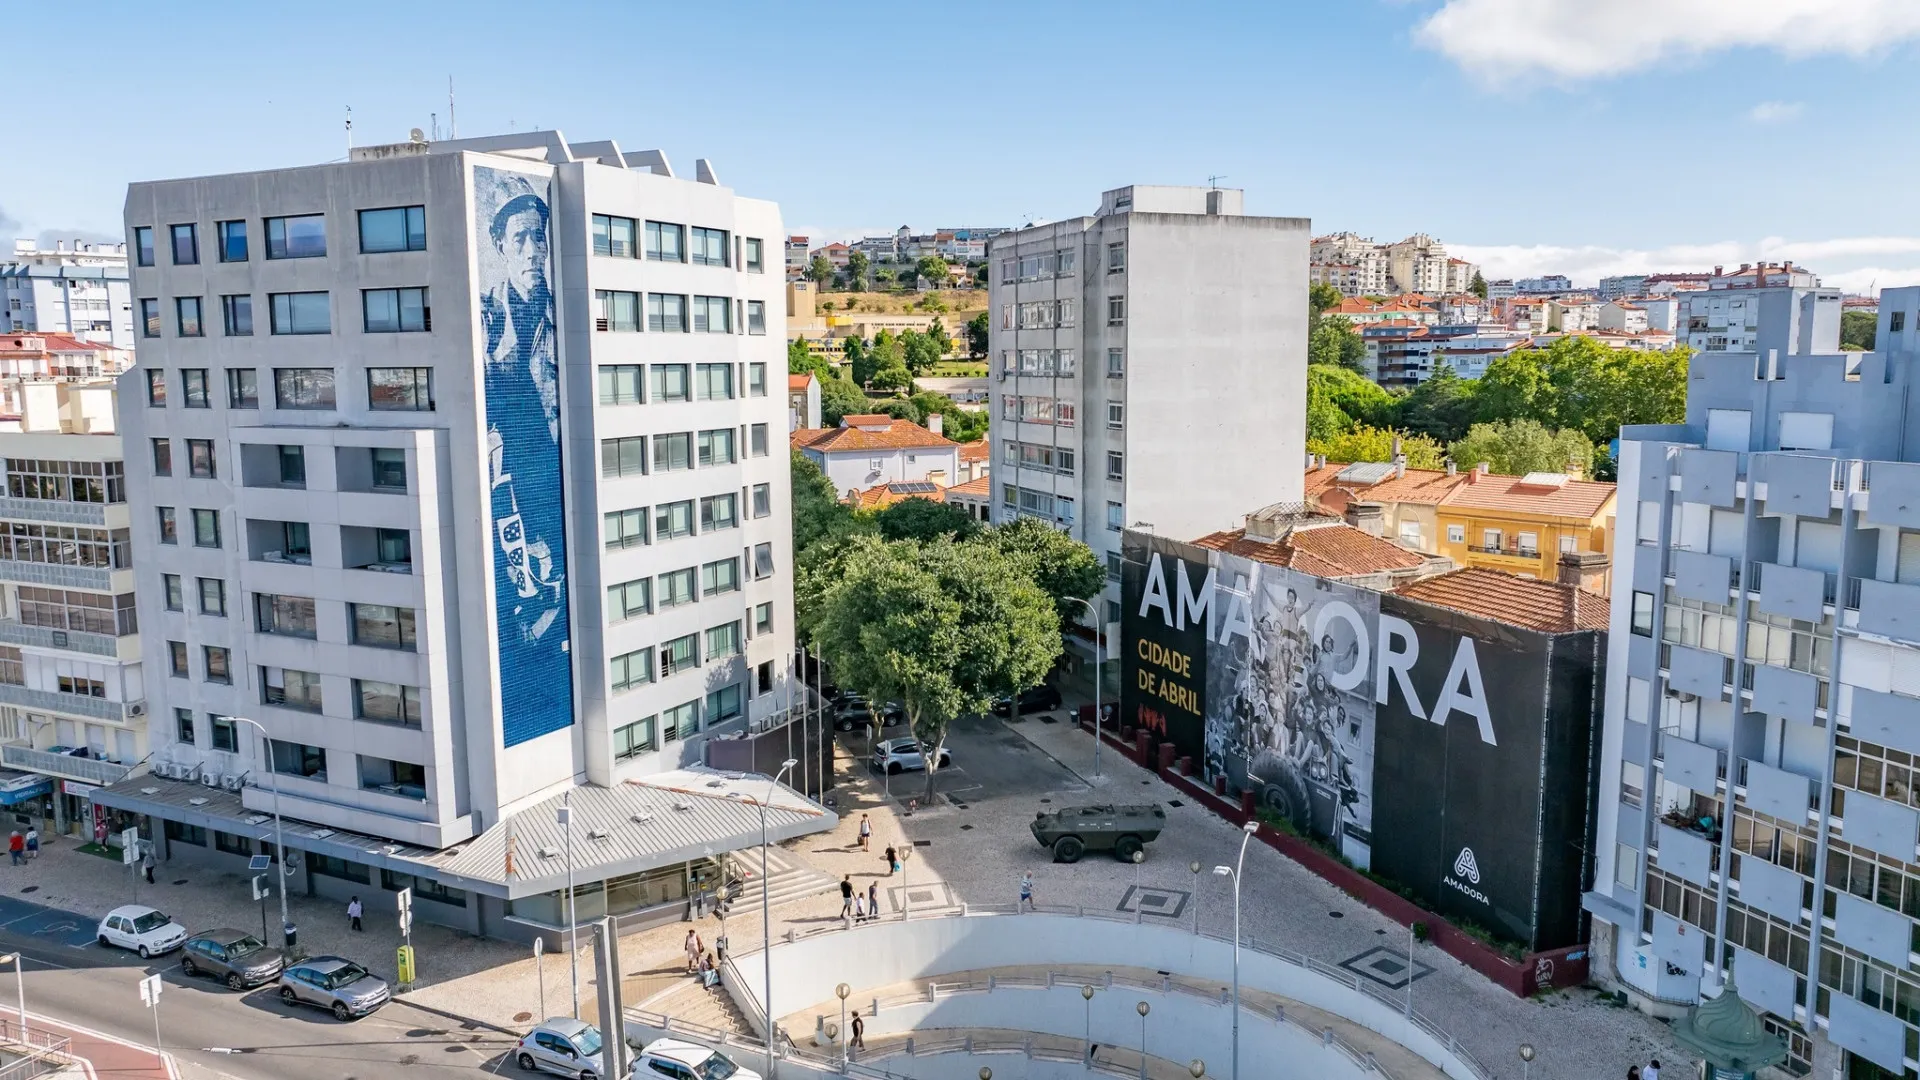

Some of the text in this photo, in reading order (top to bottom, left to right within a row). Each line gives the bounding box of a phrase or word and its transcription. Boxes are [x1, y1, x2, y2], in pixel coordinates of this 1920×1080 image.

[1138, 552, 1498, 747] AMAORA
[1138, 638, 1191, 679] CIDADE
[1138, 668, 1201, 716] DE ABRIL
[1443, 875, 1490, 906] AMADORA
